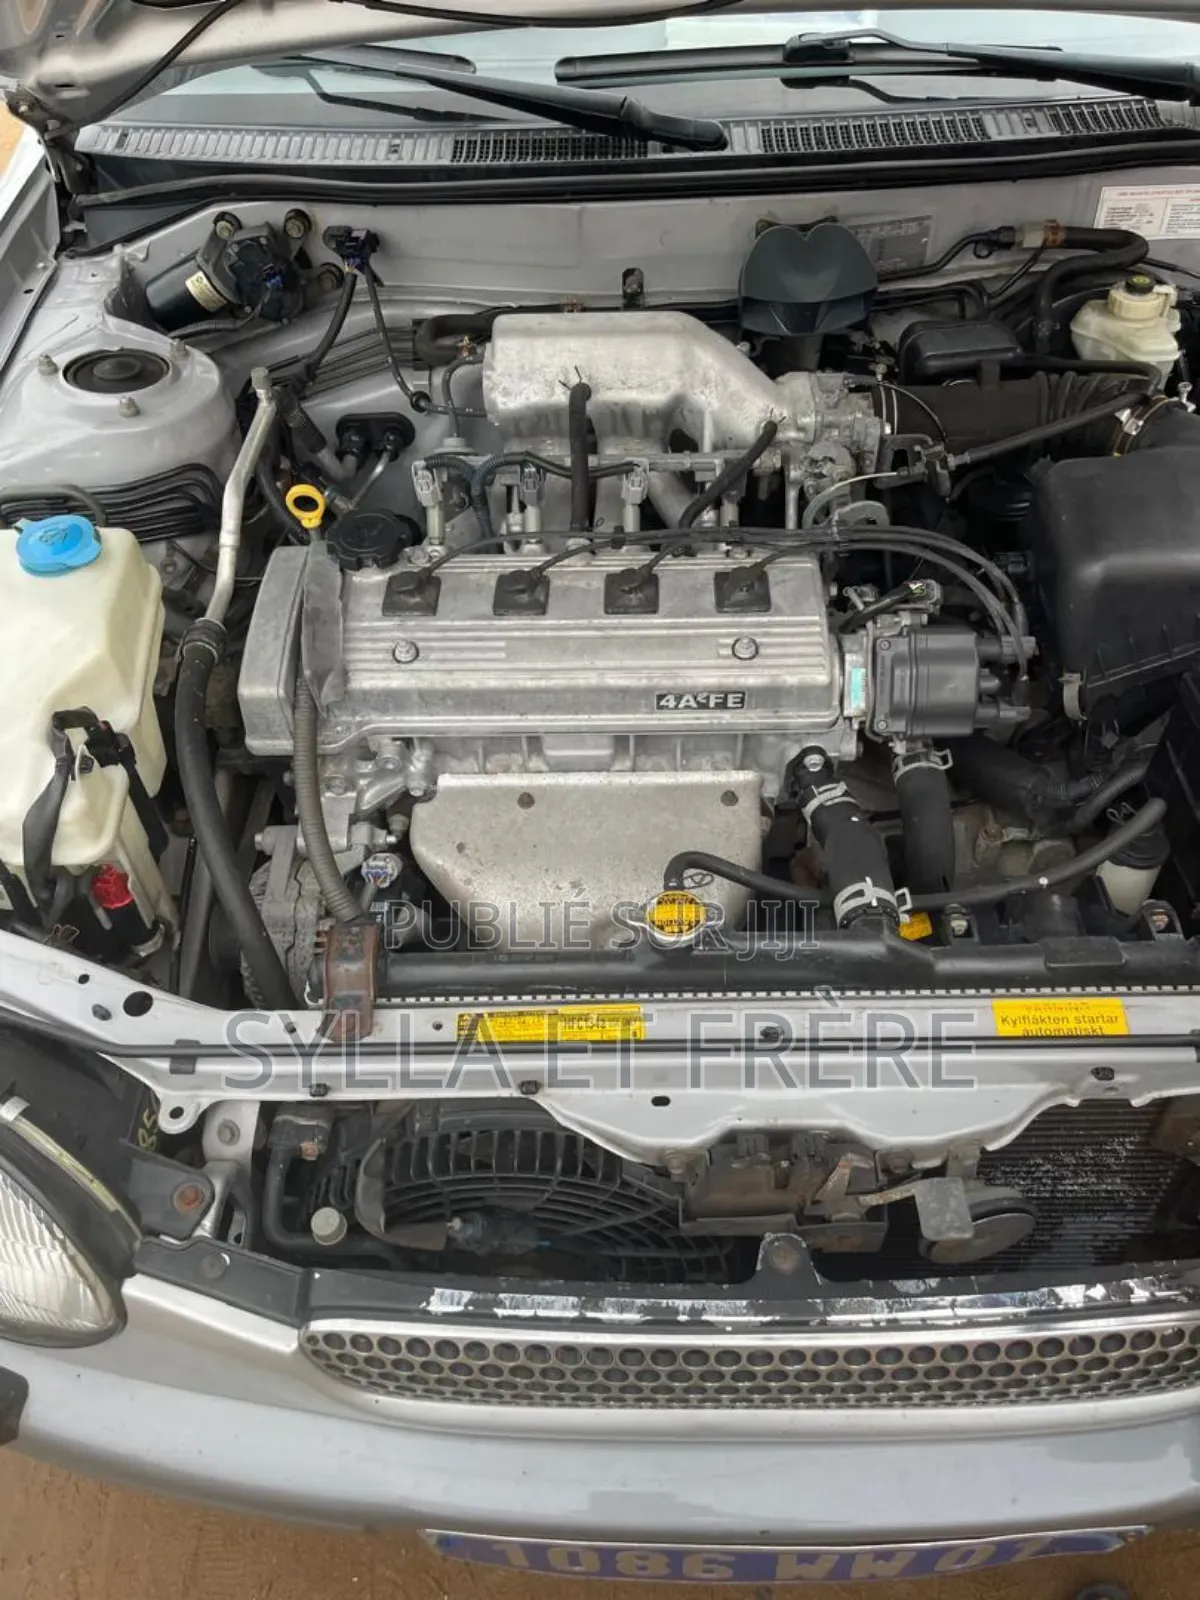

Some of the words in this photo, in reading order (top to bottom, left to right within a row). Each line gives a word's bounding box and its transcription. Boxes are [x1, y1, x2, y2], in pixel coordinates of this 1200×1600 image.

[1075, 1013, 1119, 1025] startar
[491, 1543, 735, 1580] 1086
[775, 1550, 917, 1580] WW
